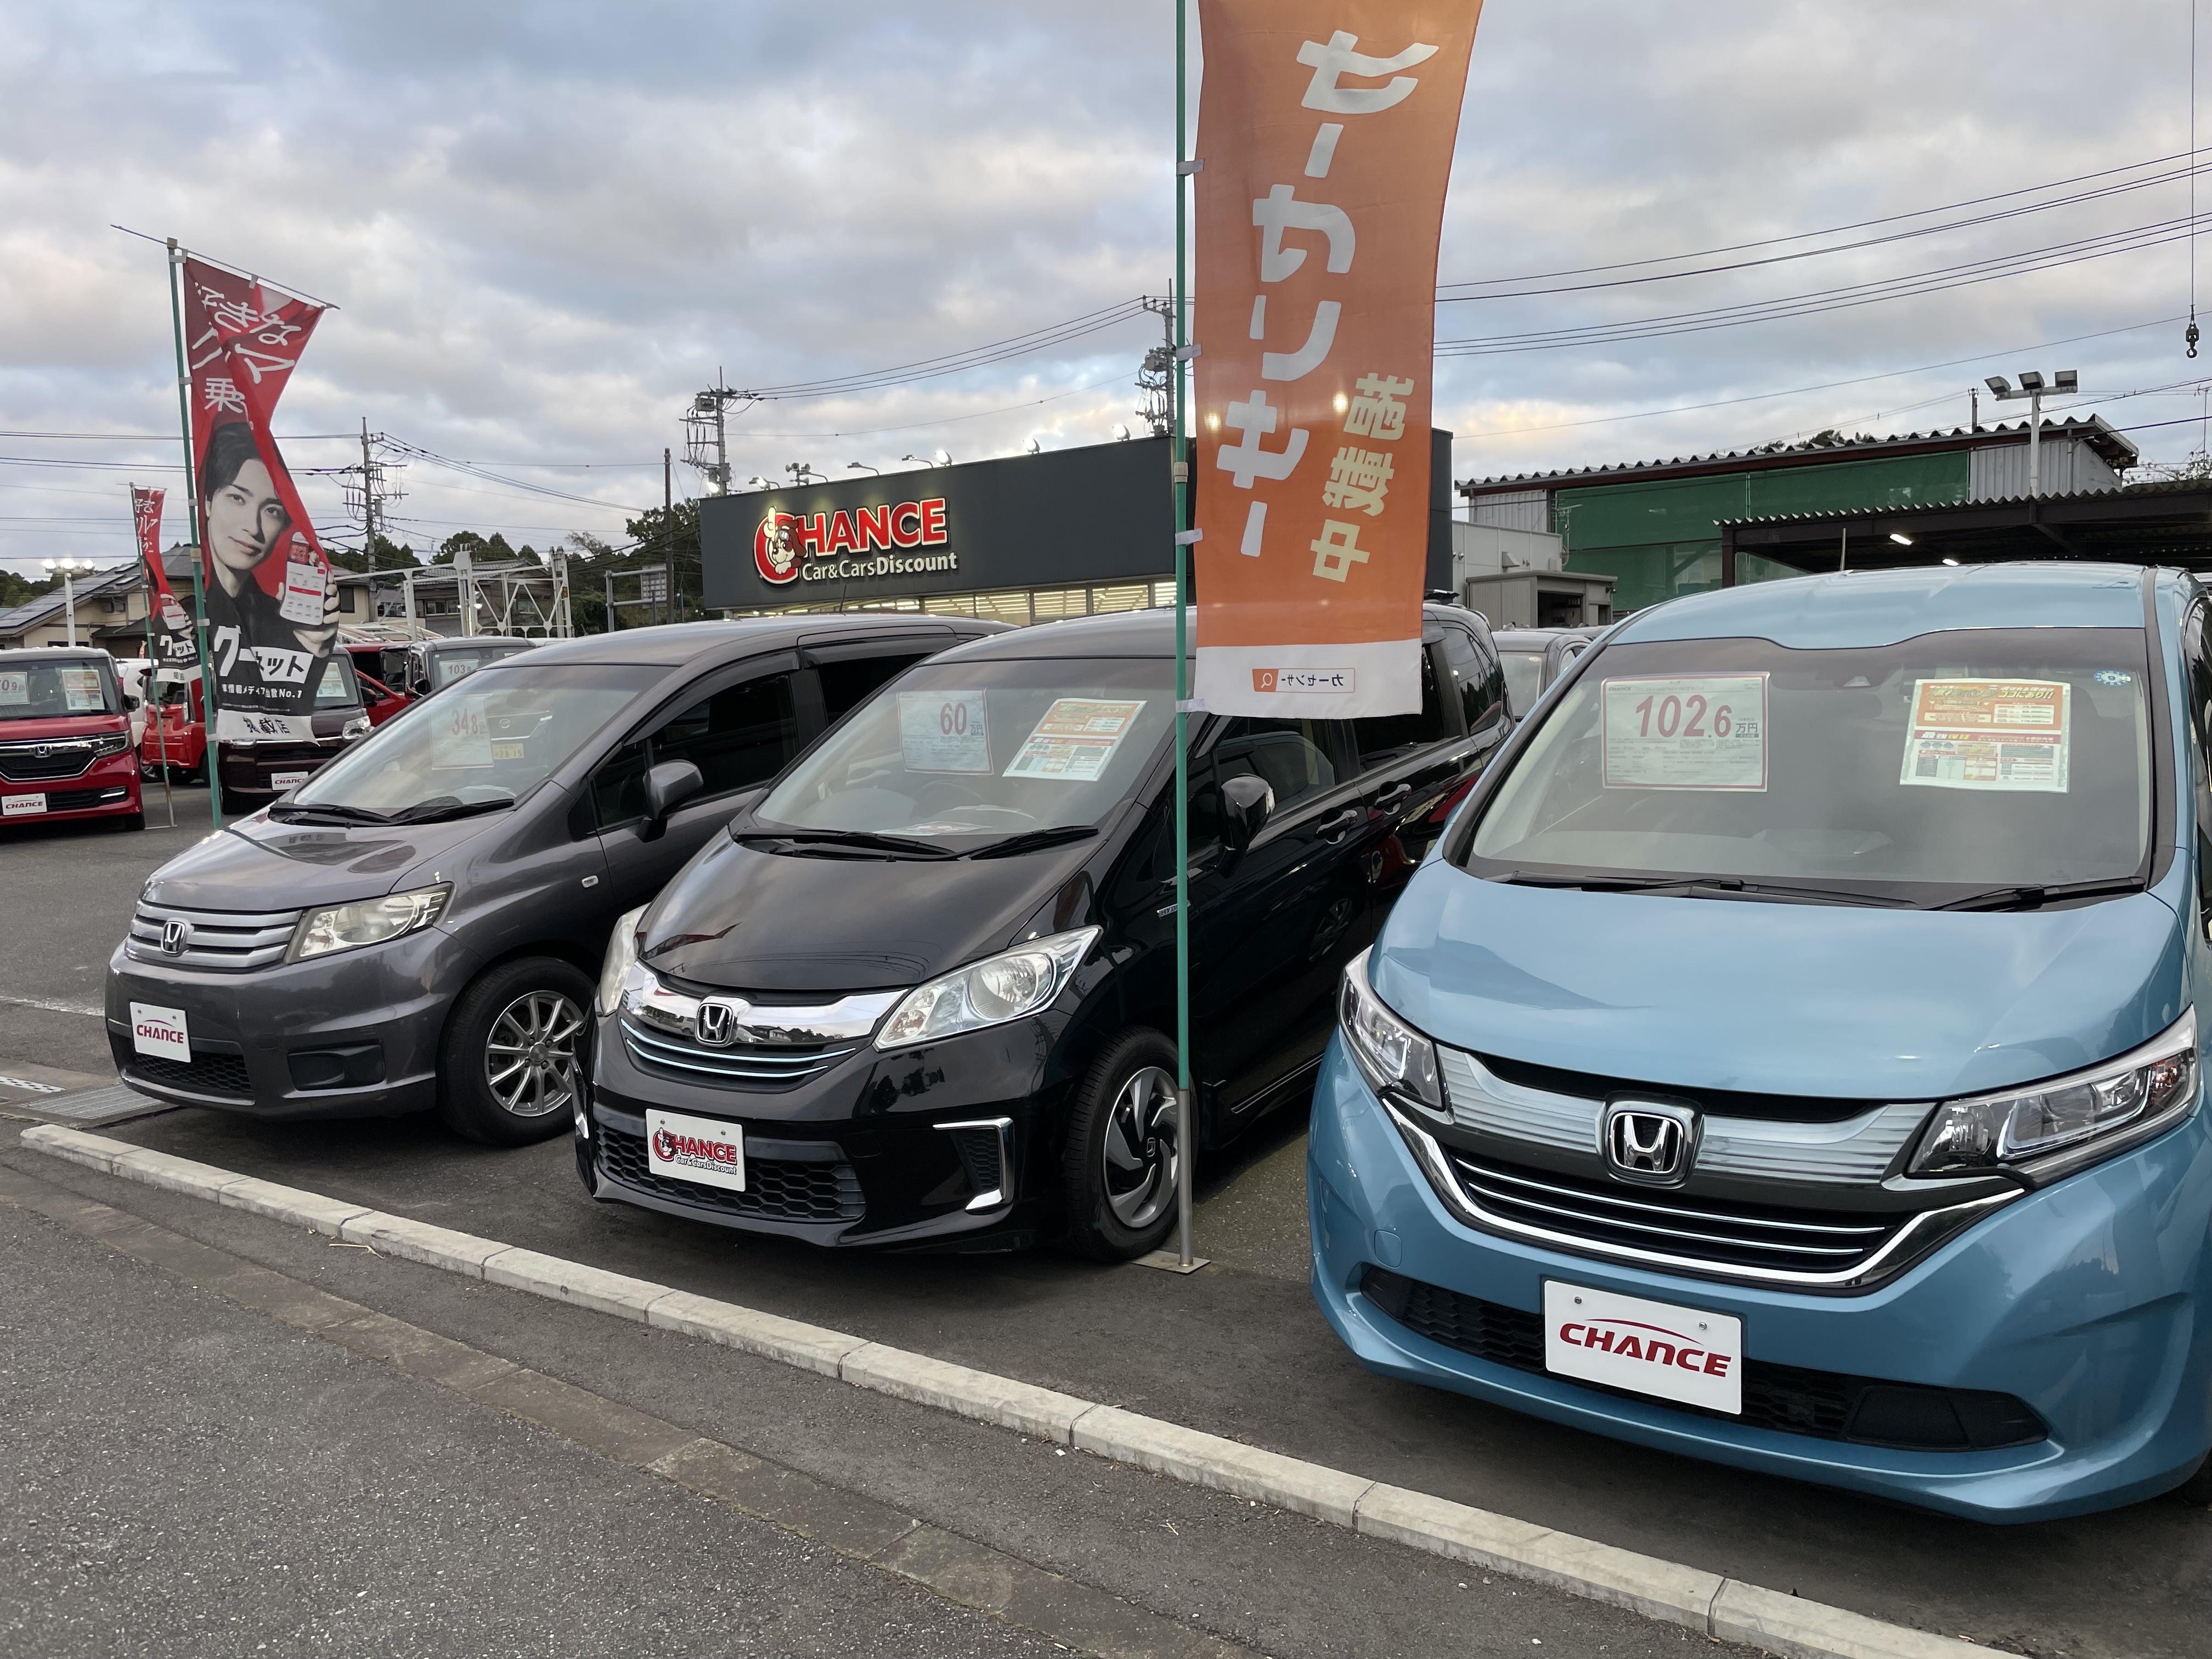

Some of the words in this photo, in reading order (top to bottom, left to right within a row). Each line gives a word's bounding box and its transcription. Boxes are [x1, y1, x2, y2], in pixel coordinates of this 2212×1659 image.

[754, 498, 949, 584] CHANCE
[940, 703, 967, 735] 60
[1635, 695, 1732, 738] 102.6
[1736, 723, 1758, 733] 万円
[137, 1024, 184, 1044] CHANCE
[653, 1130, 737, 1165] CHANCE
[1560, 1323, 1731, 1378] CHANCE
